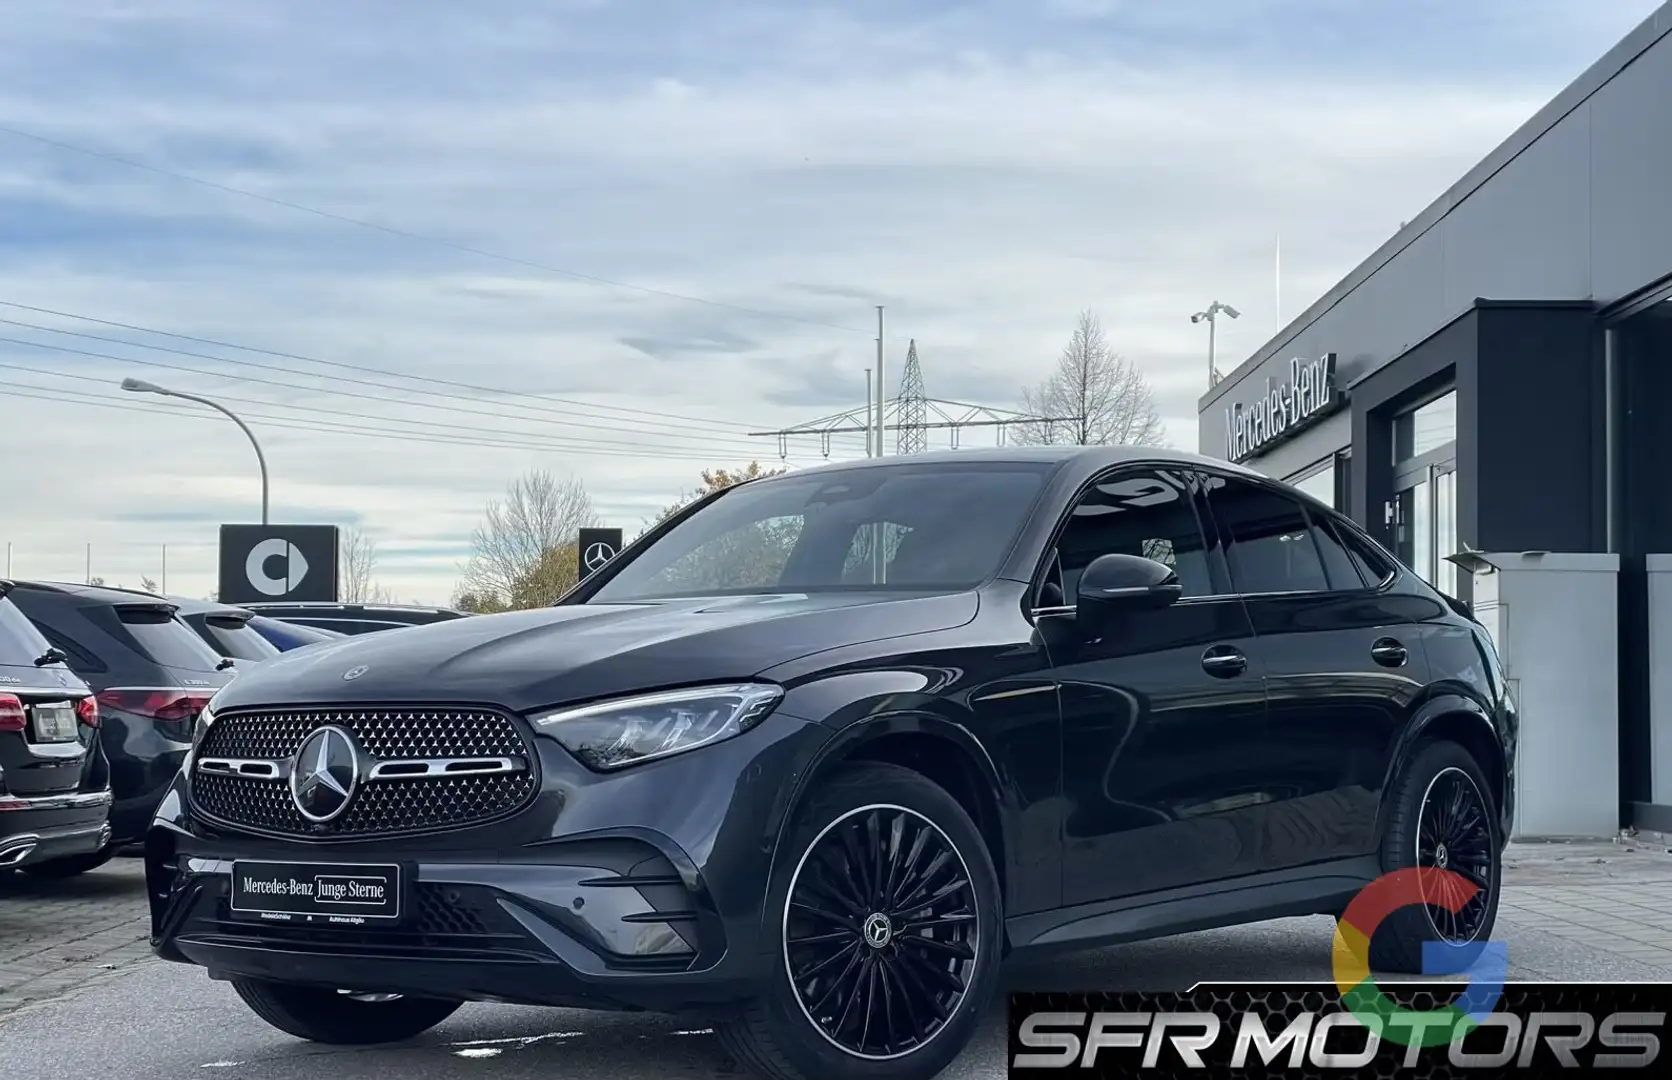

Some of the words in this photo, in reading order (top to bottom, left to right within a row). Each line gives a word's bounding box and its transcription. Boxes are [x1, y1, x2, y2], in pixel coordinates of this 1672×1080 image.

[1225, 353, 1330, 461] Mercedes-Benz
[243, 877, 314, 896] Mercedes-Benz
[317, 880, 347, 900] Junge
[348, 881, 385, 898] Sterne
